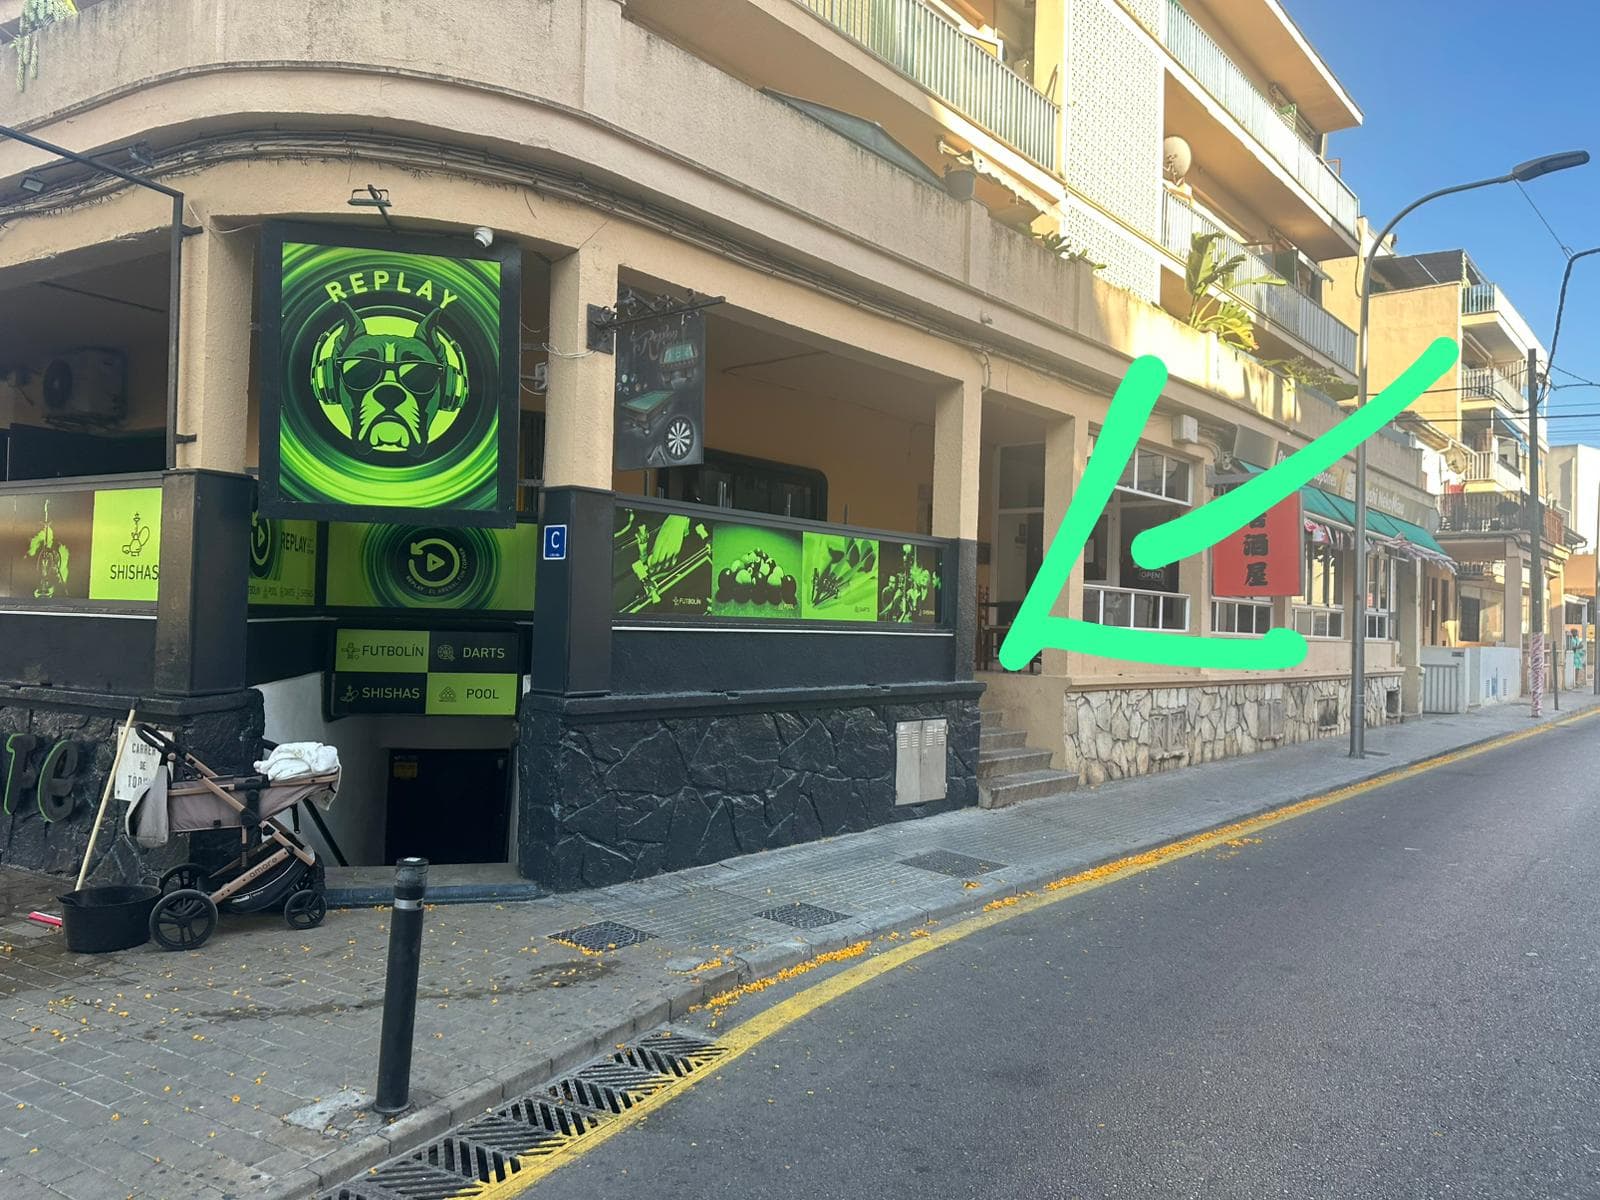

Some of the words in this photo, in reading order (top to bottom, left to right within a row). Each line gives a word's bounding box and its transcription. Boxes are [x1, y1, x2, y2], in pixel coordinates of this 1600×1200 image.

[324, 270, 458, 309] REPLAY
[280, 531, 307, 553] REPLAY
[551, 531, 560, 548] C
[110, 564, 160, 580] SHISHAS
[362, 643, 424, 657] FUTBOLÍN
[463, 647, 505, 659] DARTS
[362, 687, 420, 699] SHISHAS
[466, 688, 499, 700] POOL
[140, 761, 147, 771] DE
